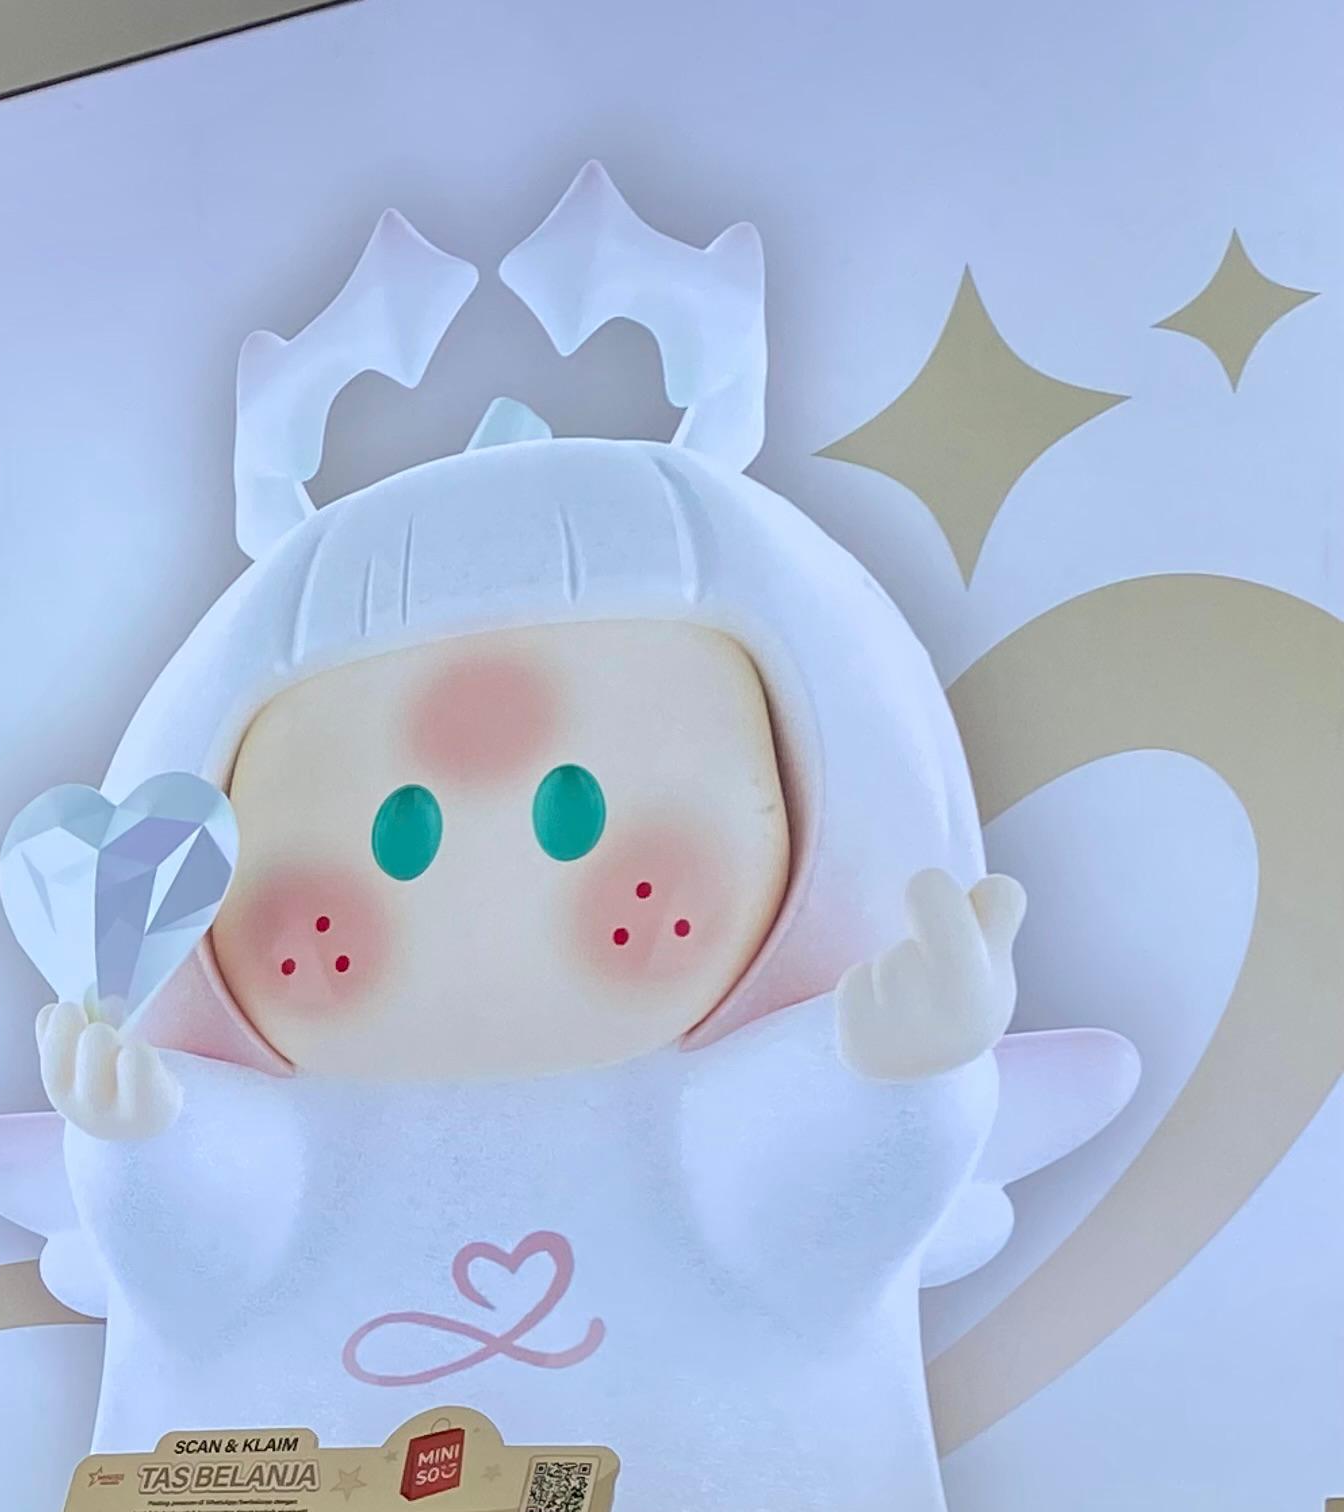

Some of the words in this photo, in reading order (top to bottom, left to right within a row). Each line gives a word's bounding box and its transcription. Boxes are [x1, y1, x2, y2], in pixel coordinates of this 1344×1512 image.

[174, 1439, 222, 1455] SCAN
[224, 1441, 238, 1453] &
[242, 1437, 299, 1453] KLAIM
[417, 1443, 460, 1467] MINI
[141, 1465, 190, 1490] TAS
[193, 1462, 317, 1489] BELANJA
